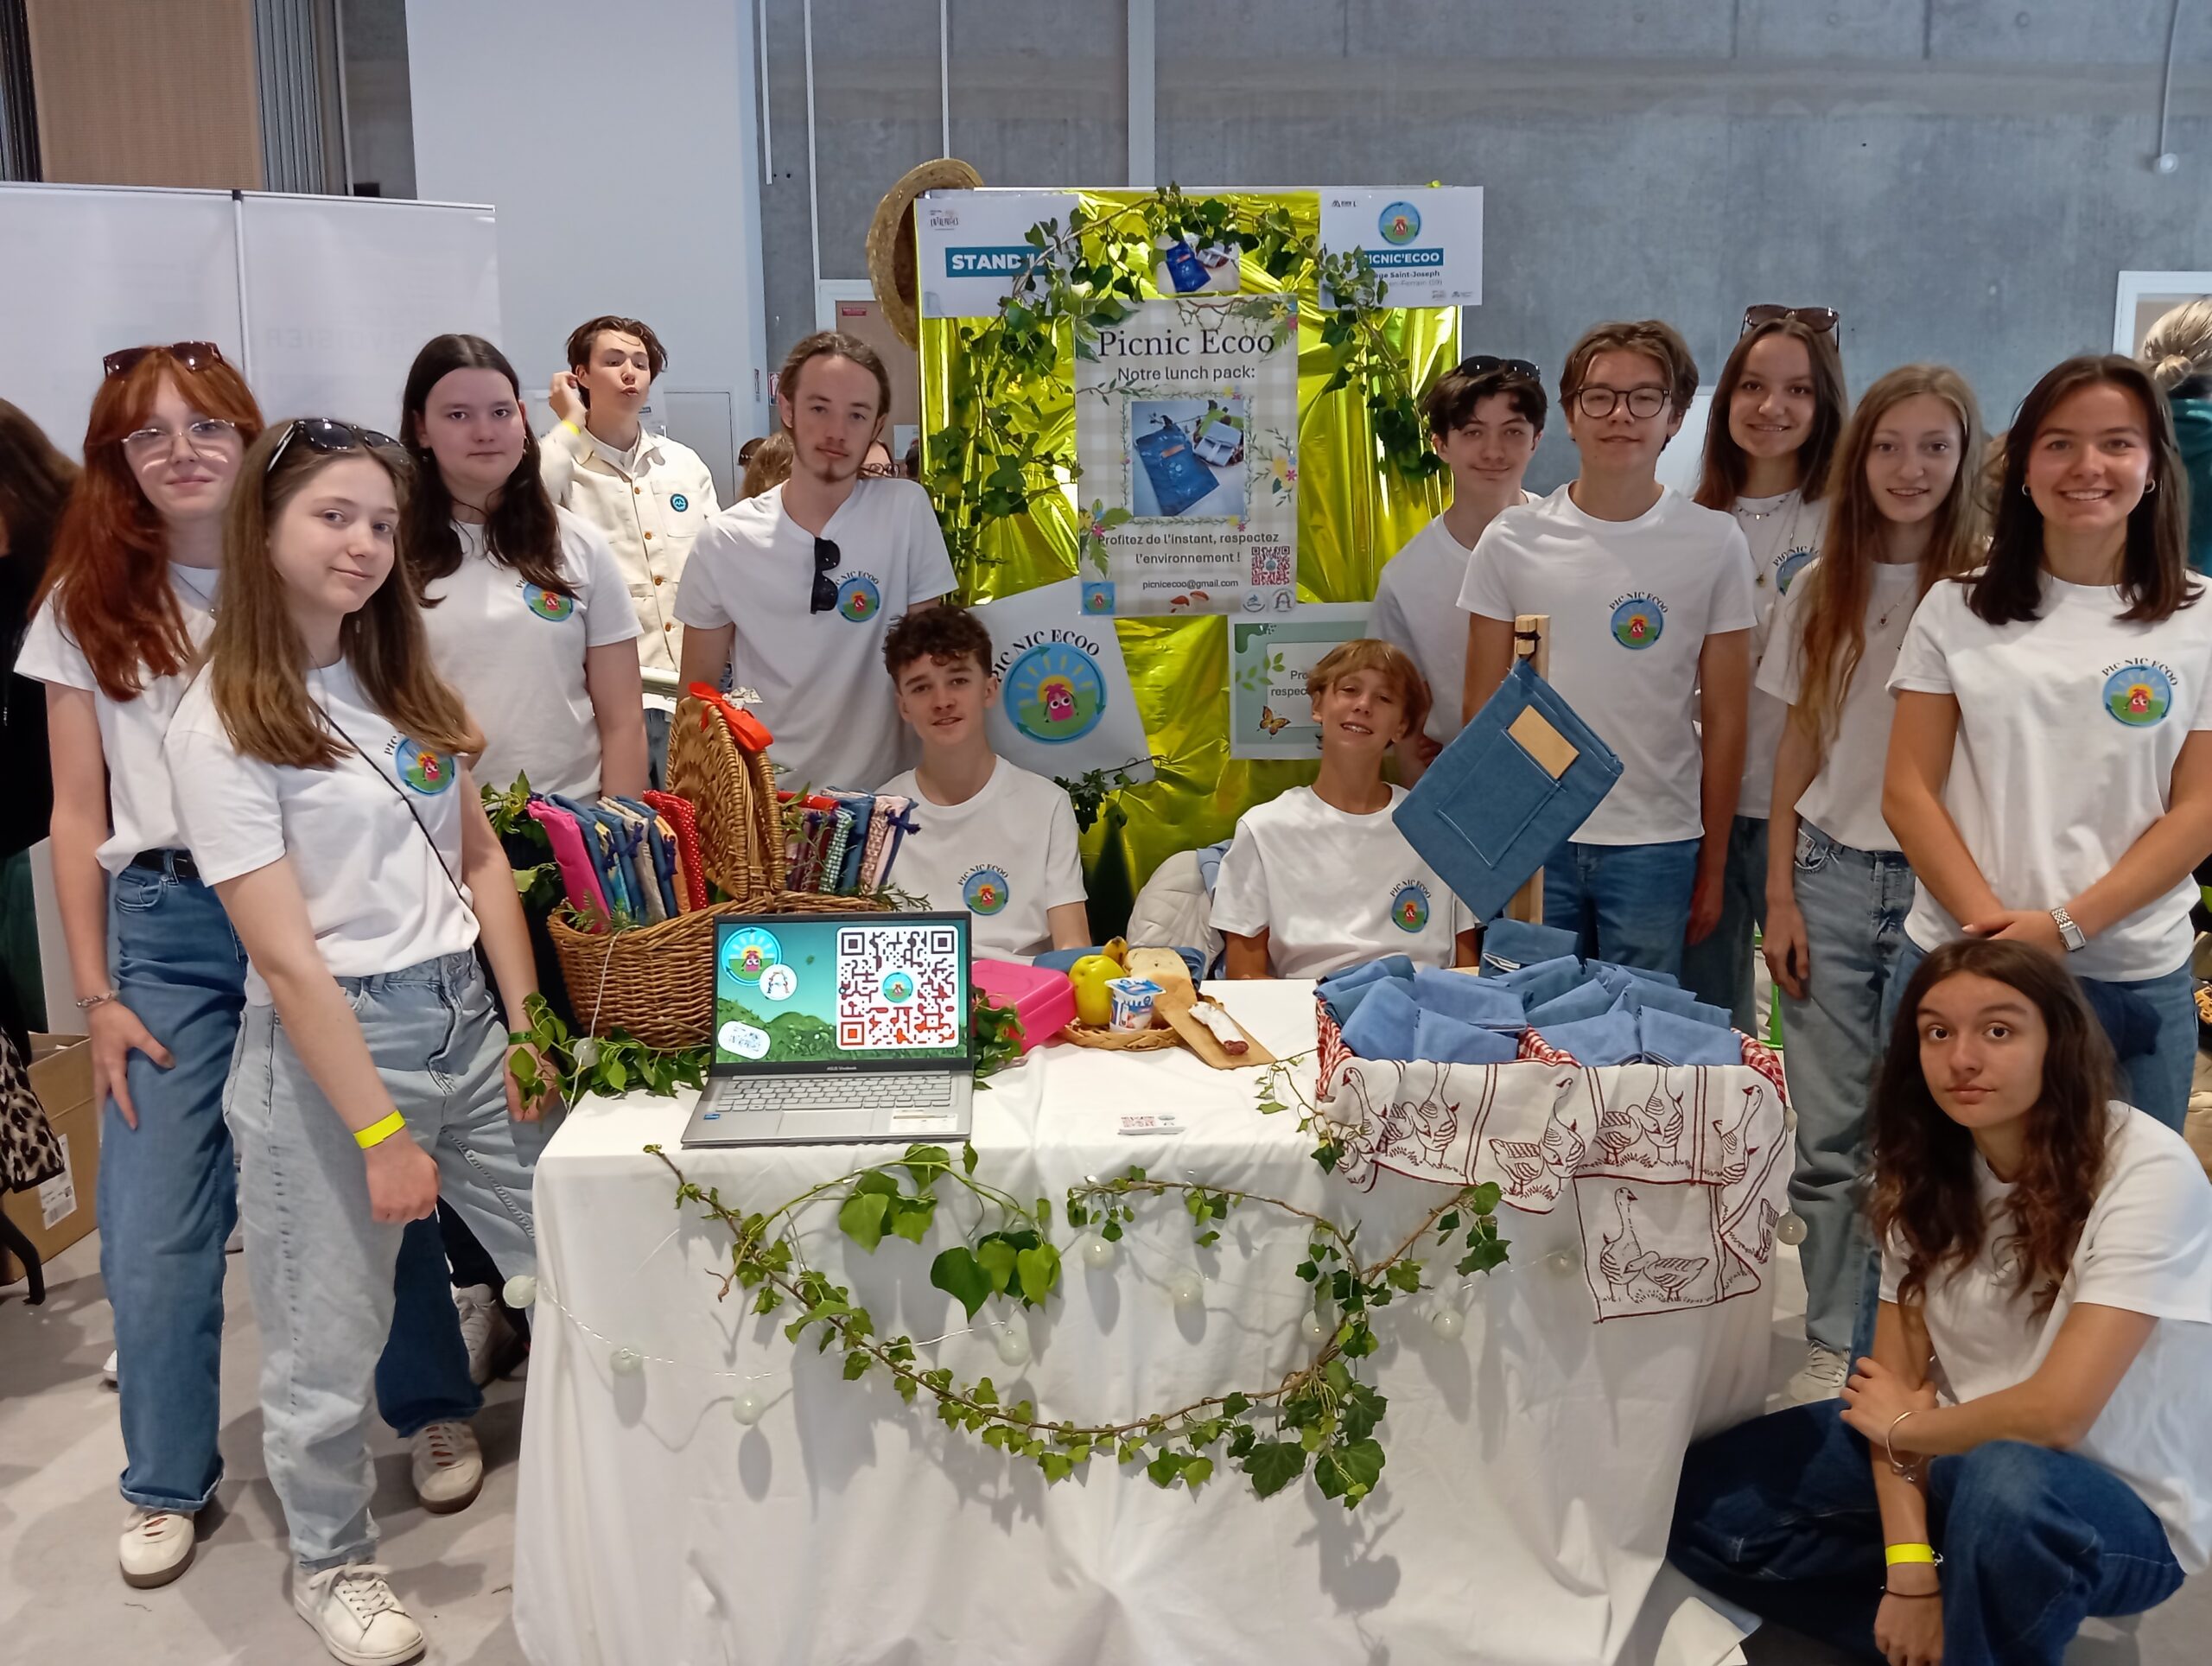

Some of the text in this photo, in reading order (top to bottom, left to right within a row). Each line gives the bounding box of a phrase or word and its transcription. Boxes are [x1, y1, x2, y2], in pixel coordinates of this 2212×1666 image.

[951, 254, 1022, 270] STAND
[1364, 252, 1440, 265] ICNIC'ECOO
[1390, 270, 1441, 279] Saint-Joseph
[1097, 327, 1275, 358] Picnic Ecoo
[1117, 364, 1255, 382] Notre lunch pack:
[1097, 532, 1280, 546] Profitez de l'instant, respectez
[1135, 551, 1241, 564] l'environnement !
[858, 570, 880, 585] ECOO
[1142, 578, 1239, 590] picnicecoo@gmail.com
[1609, 595, 1624, 610] PIC
[1646, 592, 1669, 614] ECOO
[991, 629, 1100, 683] PIC NIC ECOO
[2101, 662, 2120, 677] PIC
[2152, 659, 2178, 686] ECOO
[1270, 687, 1309, 698] respec
[957, 863, 1009, 887] PIC NIC ECOO
[1389, 882, 1402, 898] PIC
[1416, 881, 1432, 899] ECOO
